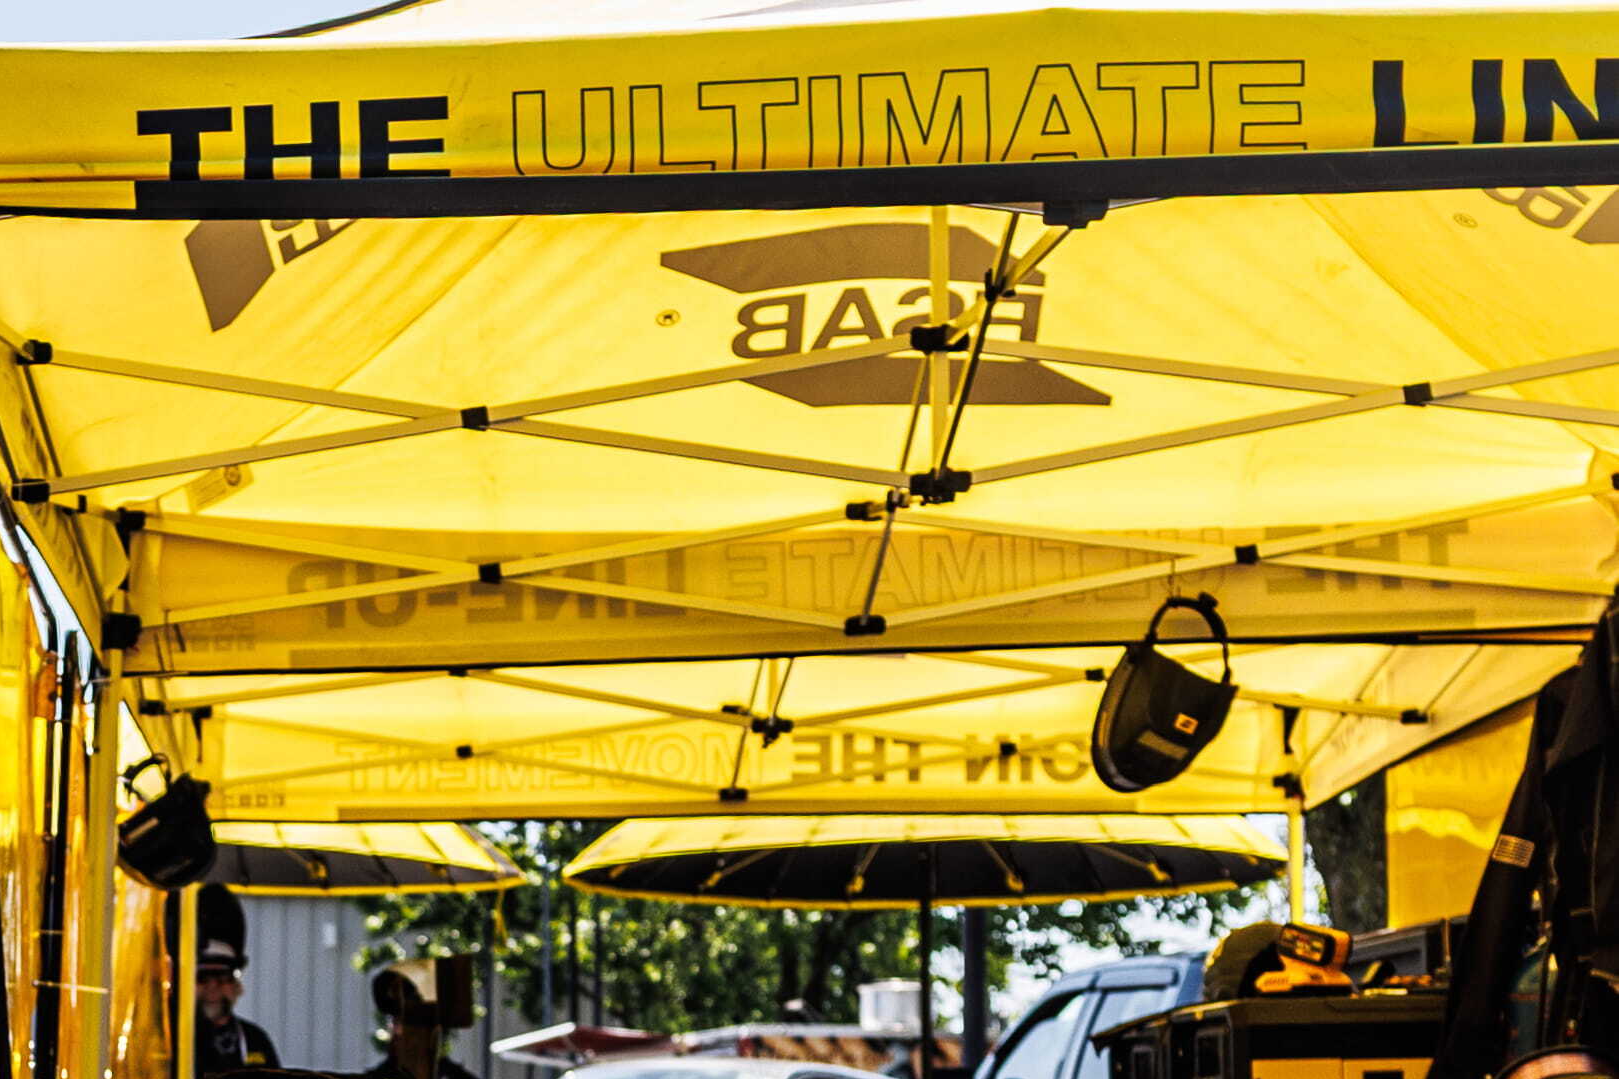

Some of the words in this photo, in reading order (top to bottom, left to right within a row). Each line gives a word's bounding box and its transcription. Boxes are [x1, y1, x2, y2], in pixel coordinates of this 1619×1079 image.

[137, 96, 451, 181] THE
[512, 59, 1308, 176] ULTIMATE
[1371, 58, 1619, 146] LIN
